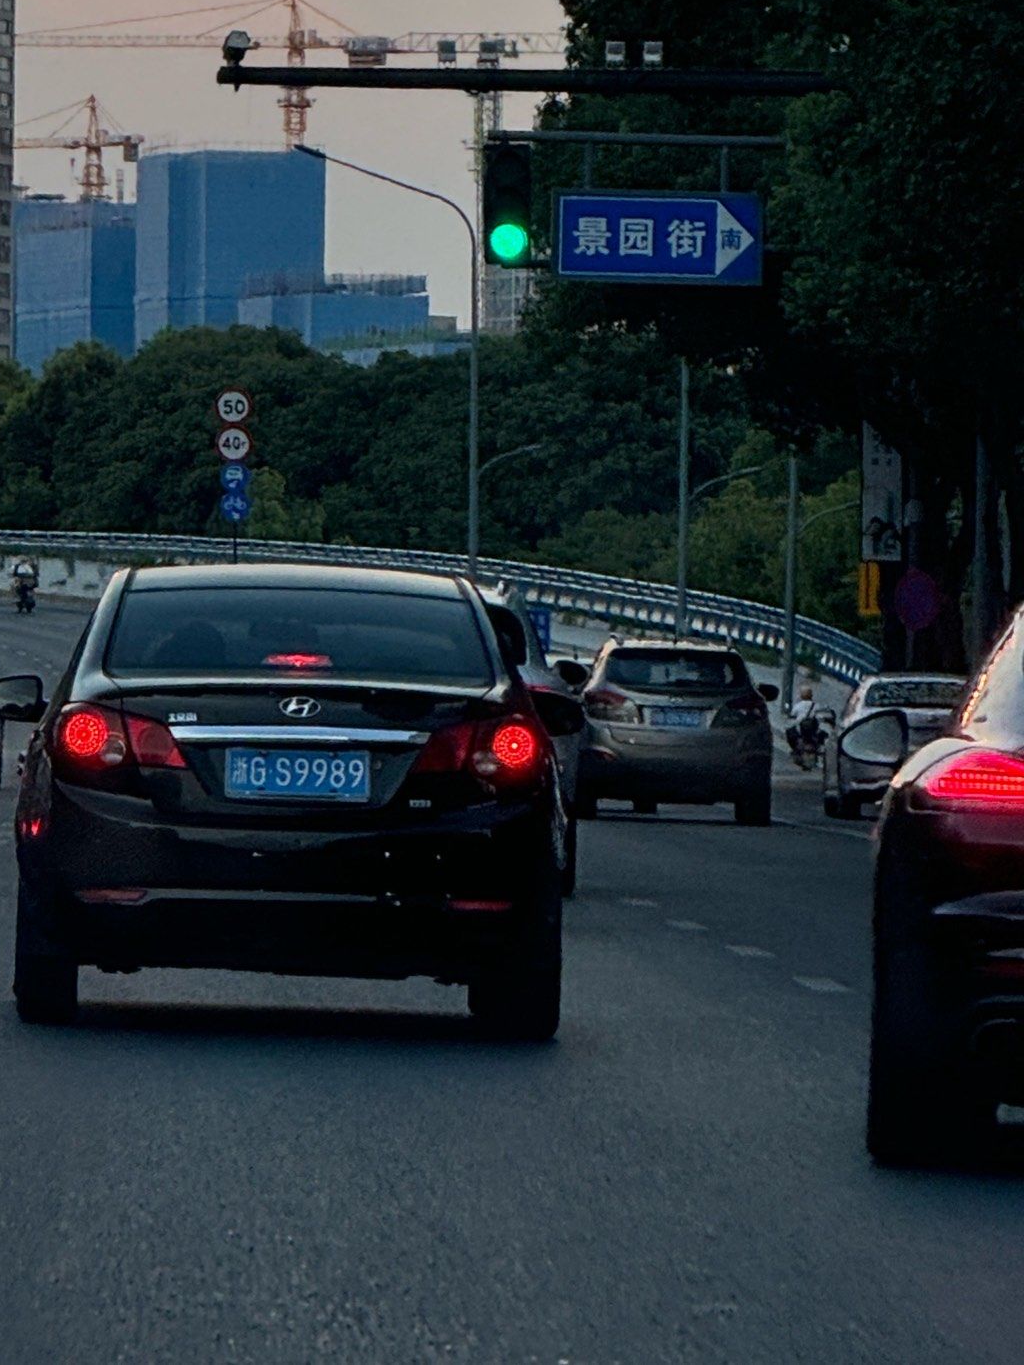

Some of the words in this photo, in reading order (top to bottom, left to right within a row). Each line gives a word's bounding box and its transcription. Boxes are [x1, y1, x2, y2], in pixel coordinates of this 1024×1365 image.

[572, 216, 707, 259] 景园街
[223, 399, 246, 415] 50
